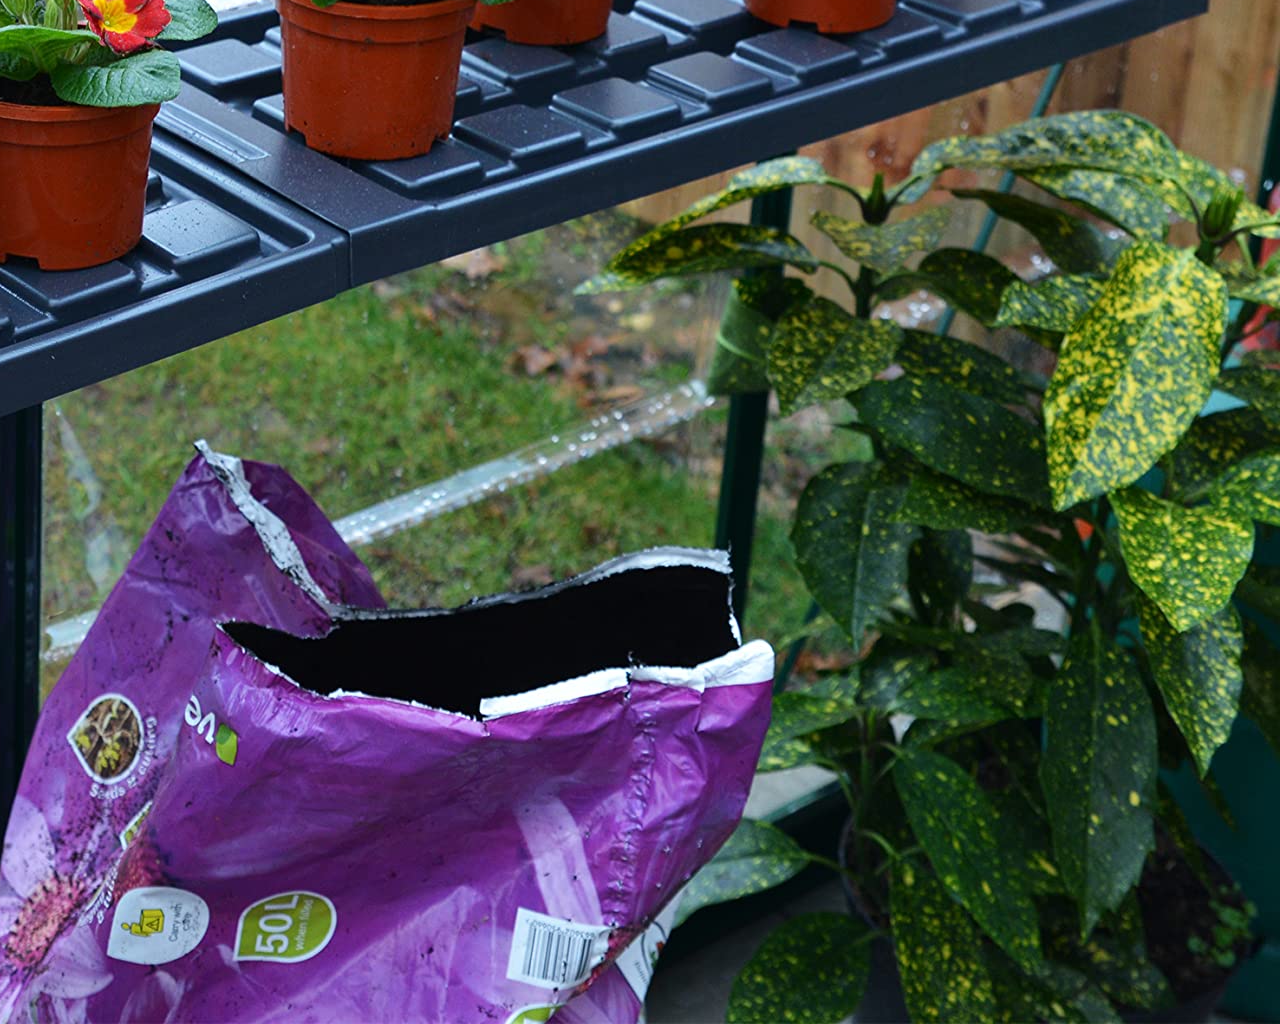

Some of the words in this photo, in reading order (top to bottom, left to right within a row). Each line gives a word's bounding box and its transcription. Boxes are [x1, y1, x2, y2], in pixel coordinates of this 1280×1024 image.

[169, 903, 183, 918] with
[299, 899, 314, 920] filled
[167, 920, 181, 943] Carry
[295, 922, 308, 951] when
